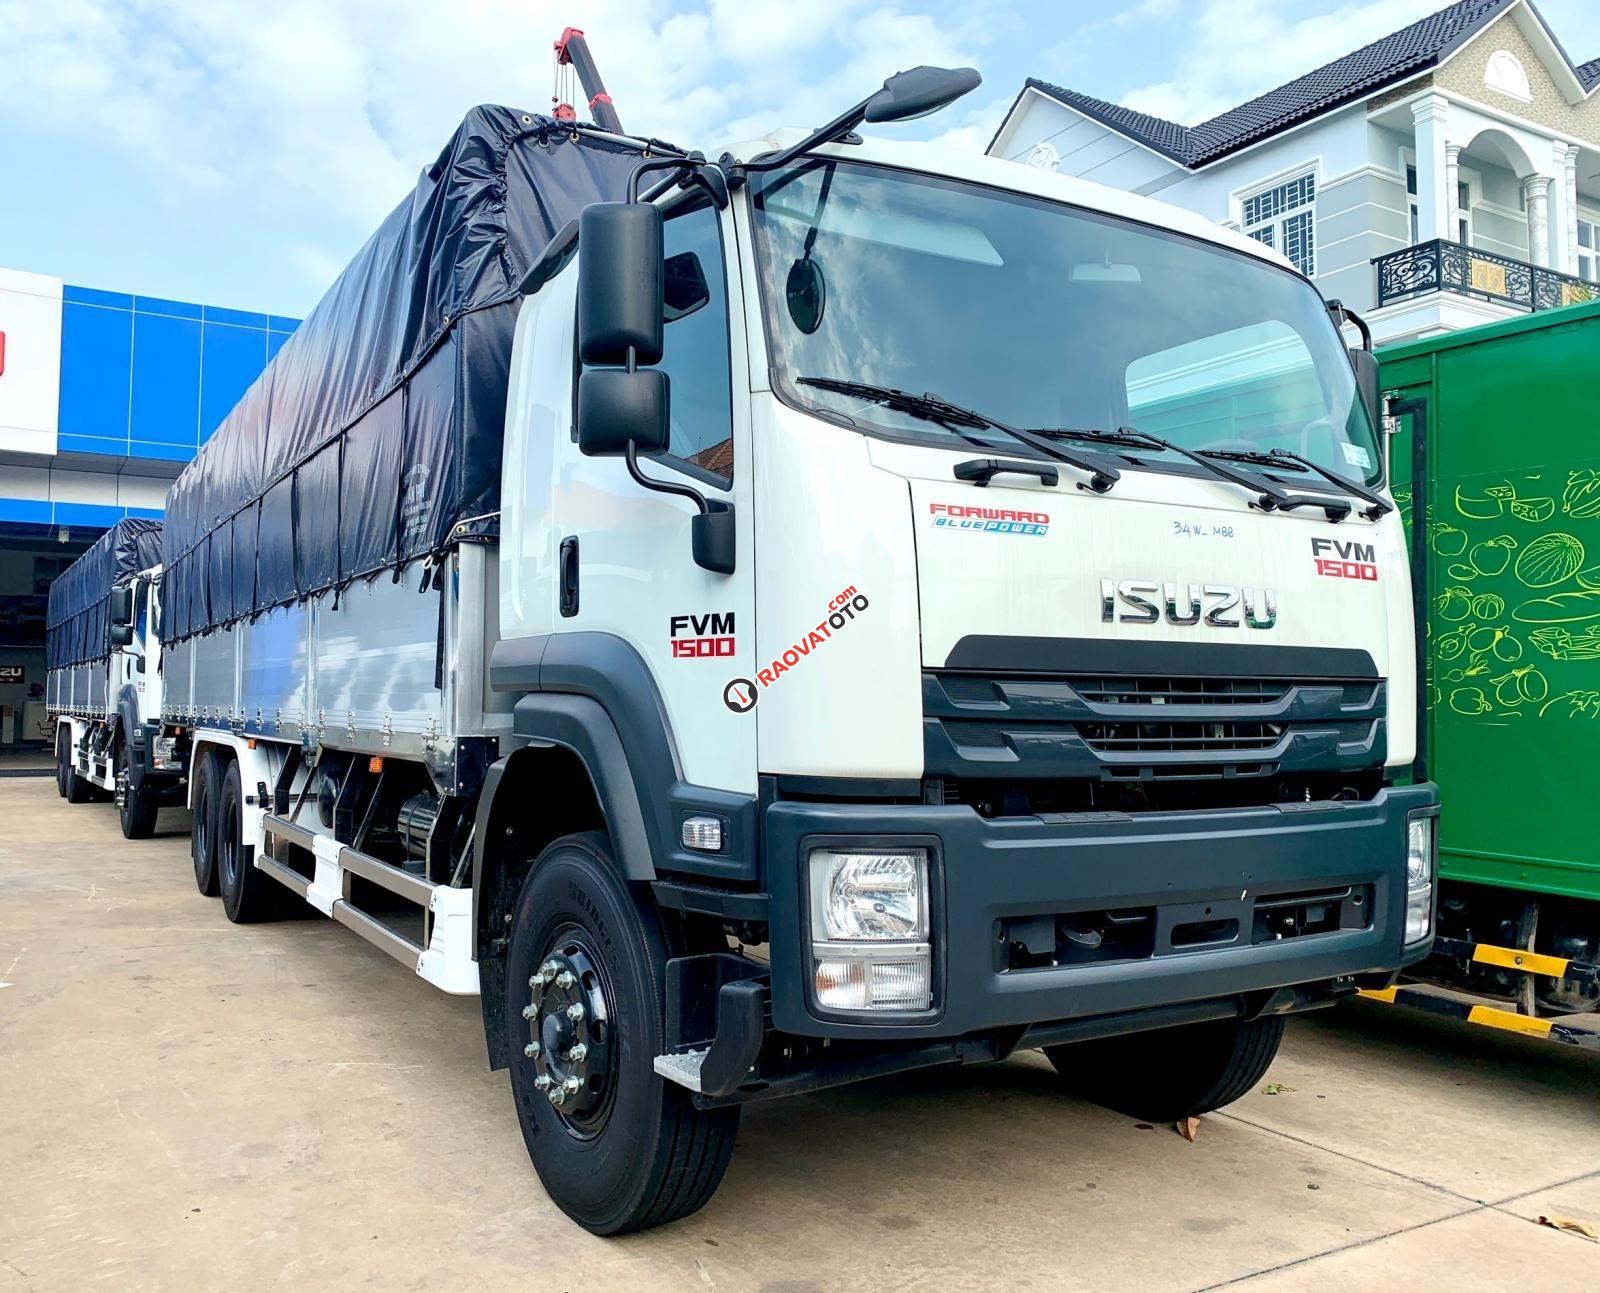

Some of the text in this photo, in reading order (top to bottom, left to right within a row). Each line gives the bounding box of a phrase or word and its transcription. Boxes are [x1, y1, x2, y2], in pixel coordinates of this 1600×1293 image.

[929, 503, 1050, 524] FORWARD
[1311, 537, 1376, 563] FVM
[1314, 558, 1378, 582] 1500
[1100, 577, 1277, 630] ISUZU
[670, 612, 735, 637] FVM
[670, 637, 735, 658] 1500
